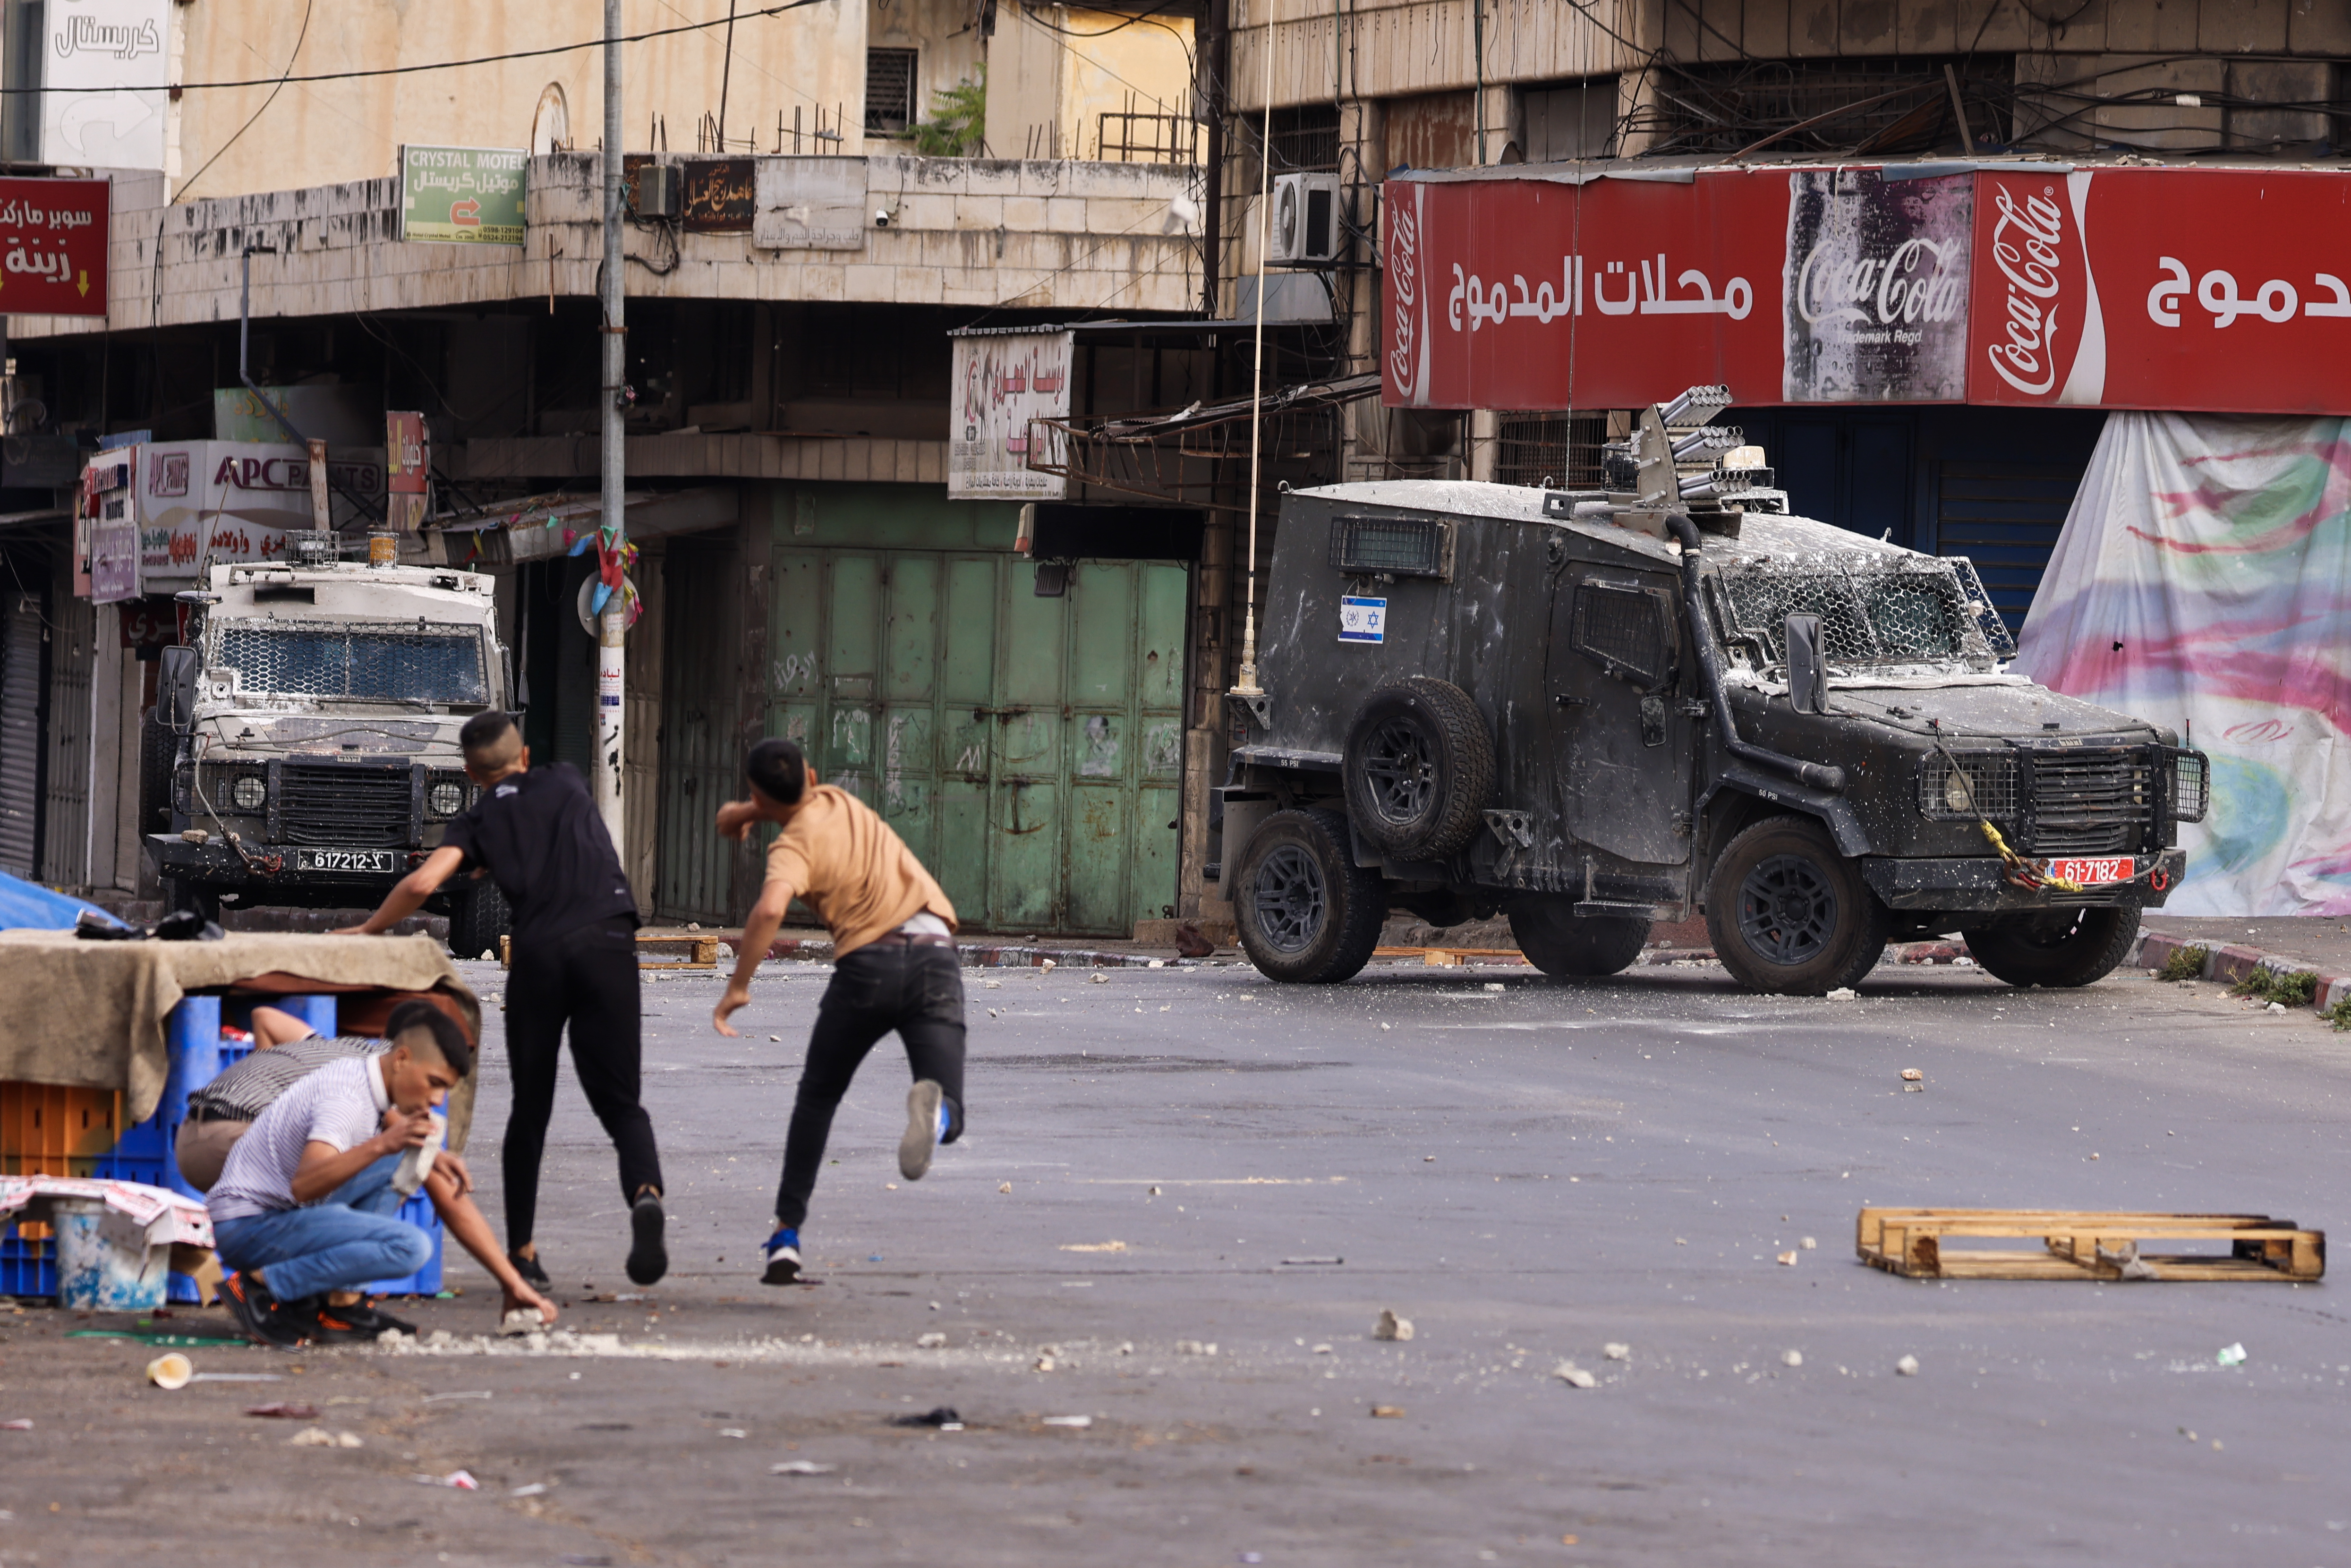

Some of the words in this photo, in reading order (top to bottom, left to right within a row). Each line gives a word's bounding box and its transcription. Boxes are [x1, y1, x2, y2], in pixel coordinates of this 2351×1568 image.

[55, 16, 159, 60] كريستال
[409, 150, 470, 168] CRYSTAL
[477, 153, 525, 170] MOTEL
[413, 170, 475, 193] كريستل
[476, 172, 519, 195] موتيل
[48, 210, 92, 230] سوبر
[792, 227, 809, 245] الفم
[811, 228, 841, 243] وجراحة
[843, 227, 858, 244] طب
[6, 237, 71, 283] زينة
[1594, 254, 1753, 321] محلات
[1797, 238, 1963, 325] Coca-Cola
[1988, 181, 2062, 395] Coca-Cola
[1390, 200, 1415, 398] Coca-Cola
[1449, 255, 1582, 332] المدموج
[401, 434, 422, 475] حلويات
[213, 455, 284, 490] APC
[1281, 759, 1288, 767] 55
[1289, 759, 1299, 768] PSI
[1759, 789, 1766, 797] 50
[1768, 791, 1778, 801] PSI
[2064, 860, 2119, 881] 61-7182
